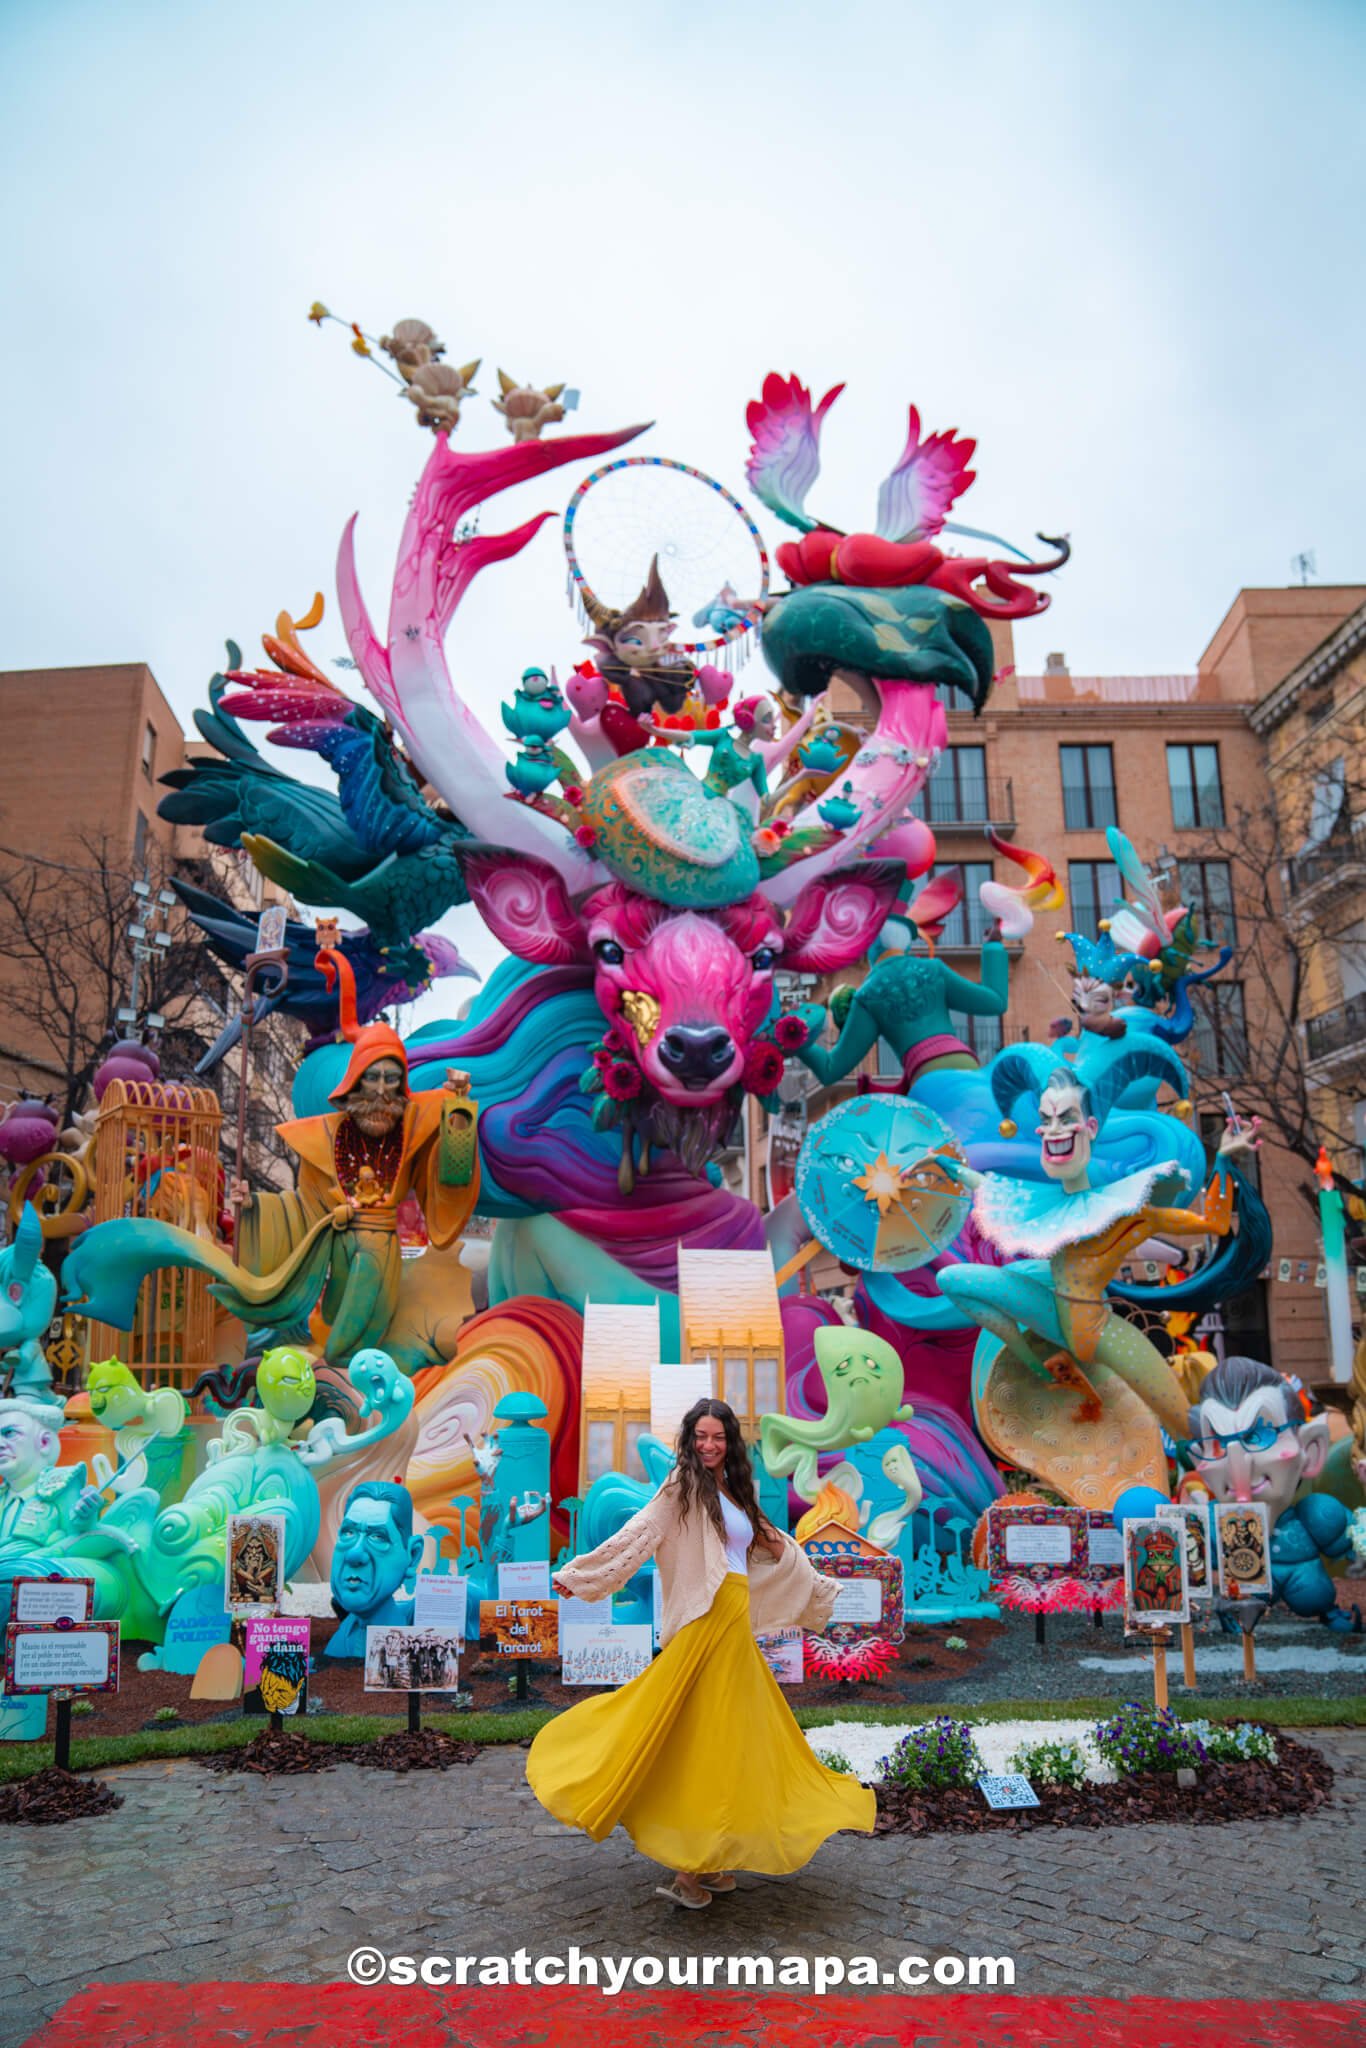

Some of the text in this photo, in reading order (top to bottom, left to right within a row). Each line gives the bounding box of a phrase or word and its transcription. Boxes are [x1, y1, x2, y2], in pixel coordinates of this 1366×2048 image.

[495, 1605, 544, 1617] El Tarot
[253, 1623, 308, 1637] No tengo
[509, 1623, 529, 1635] del
[249, 1634, 287, 1645] ganas
[256, 1641, 307, 1653] de dana.
